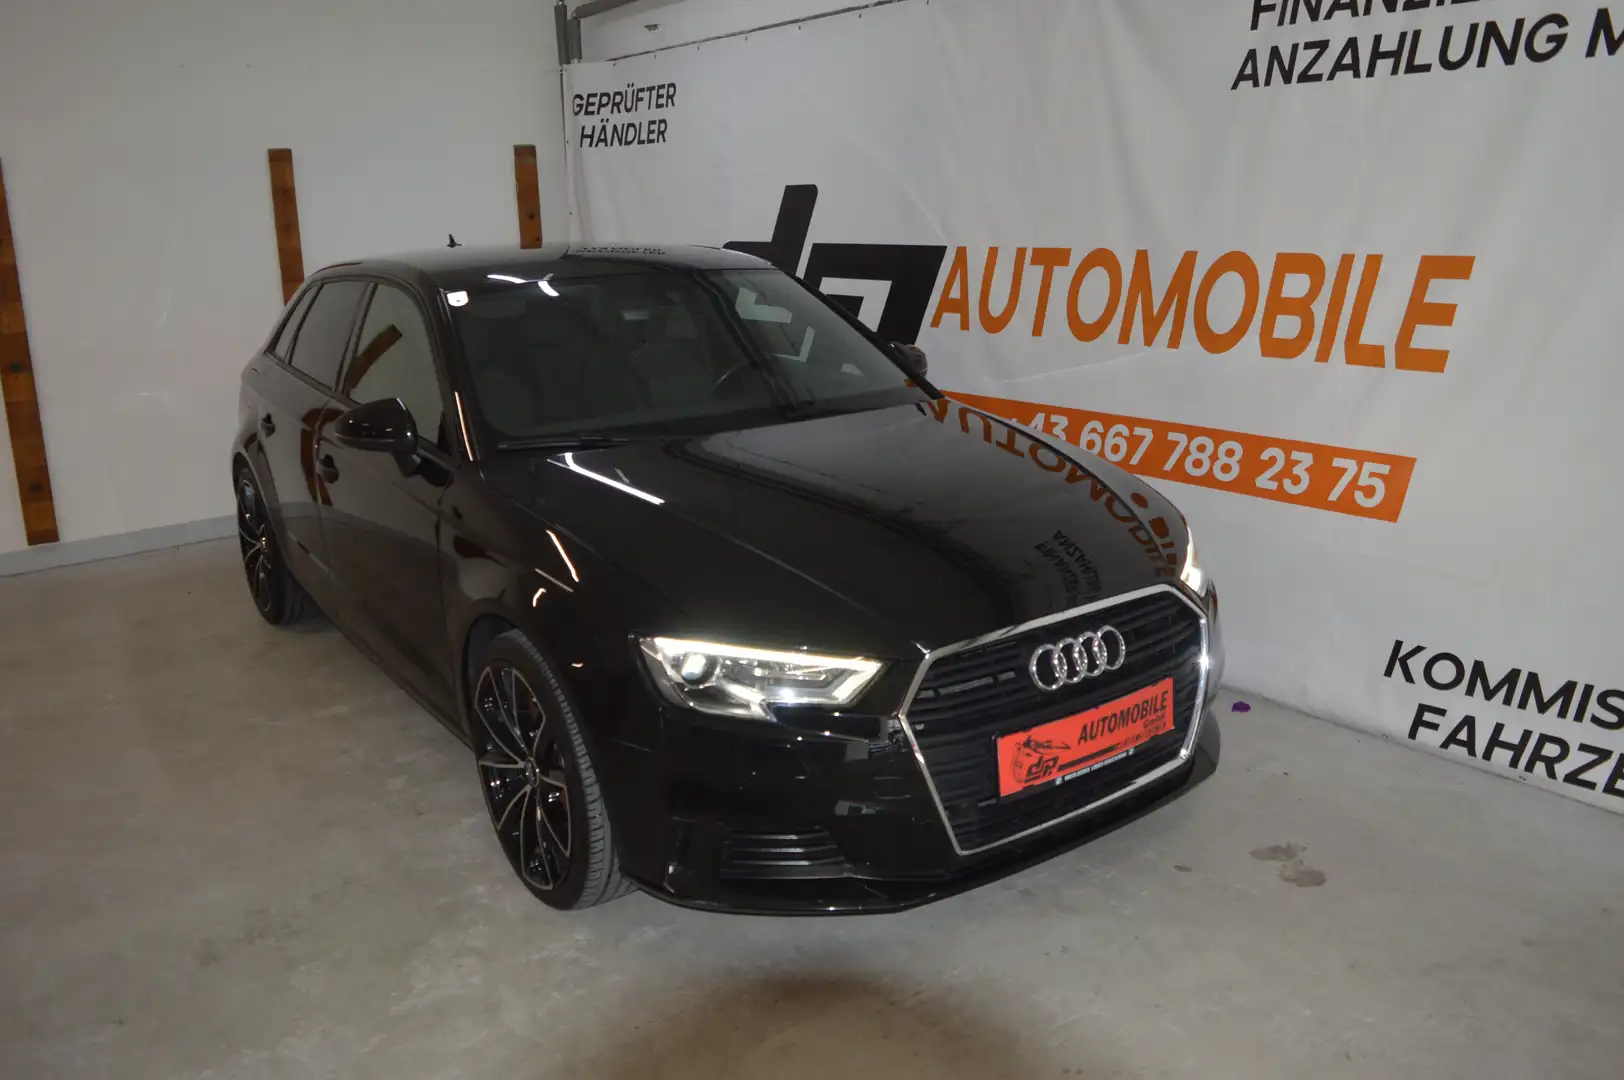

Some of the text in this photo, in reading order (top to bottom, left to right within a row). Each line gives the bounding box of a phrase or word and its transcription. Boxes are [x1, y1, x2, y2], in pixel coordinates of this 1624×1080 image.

[1230, 13, 1569, 90] ANZAHLUNG
[572, 82, 677, 116] GEPRÜFTER
[580, 118, 668, 148] HÄNDLER
[930, 245, 1476, 373] AUTOMOBILE
[1079, 419, 1154, 466] 667
[1162, 431, 1244, 482] 788
[1255, 447, 1314, 495] 23
[1327, 457, 1392, 508] 75
[1077, 690, 1169, 746] AUTOMOBILE
[1383, 639, 1624, 731] KOMMIS
